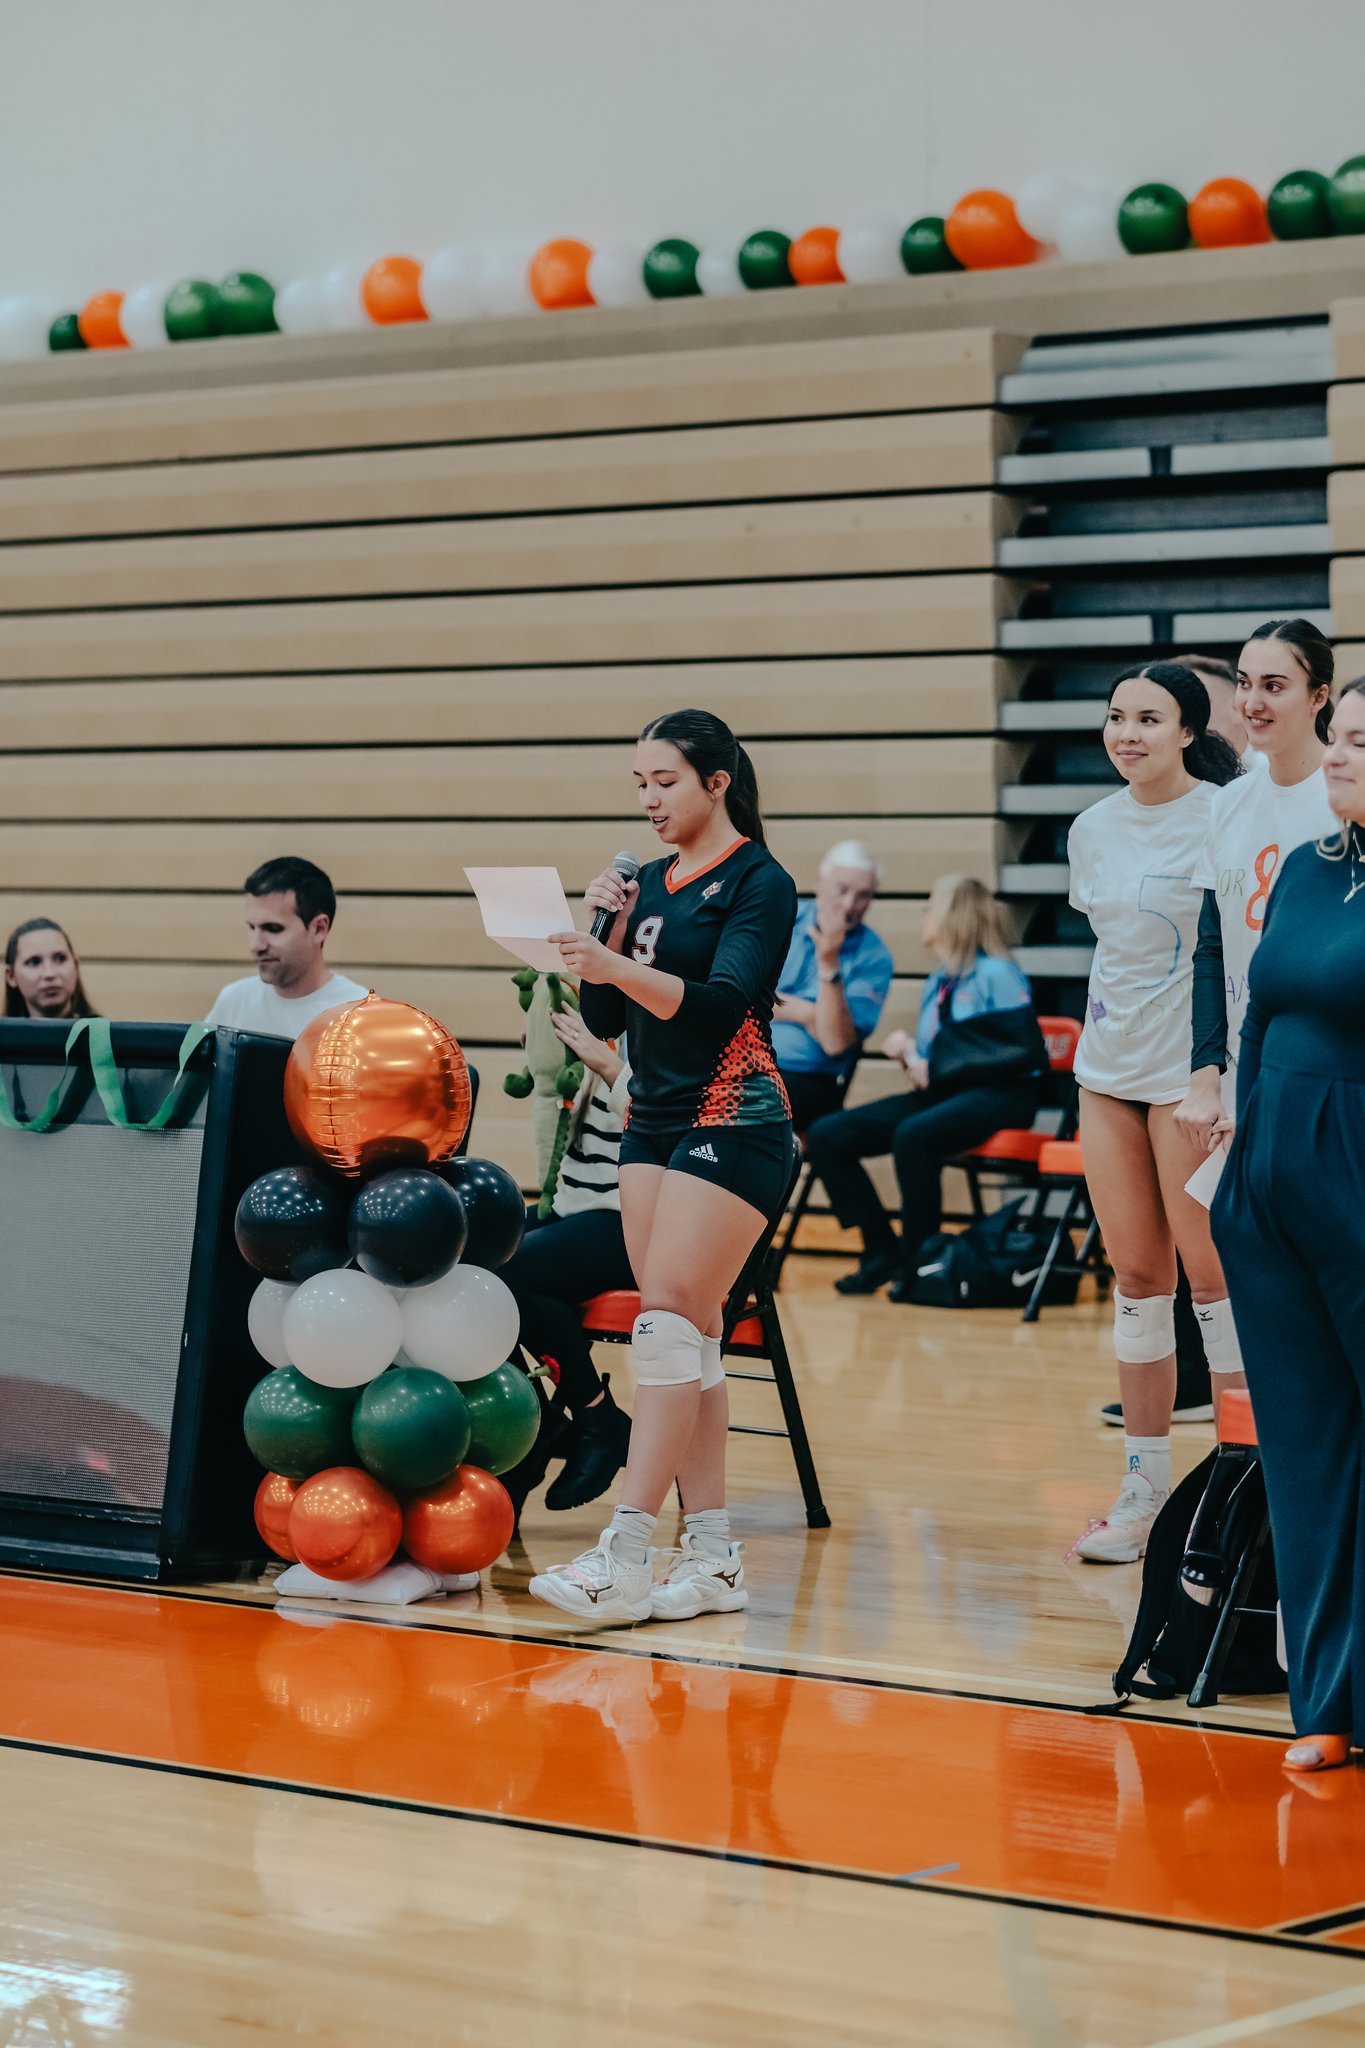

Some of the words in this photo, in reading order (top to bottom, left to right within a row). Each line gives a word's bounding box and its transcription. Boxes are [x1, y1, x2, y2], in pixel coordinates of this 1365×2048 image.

[1245, 843, 1279, 931] 8
[632, 915, 664, 965] 9
[688, 1149, 719, 1163] adidas
